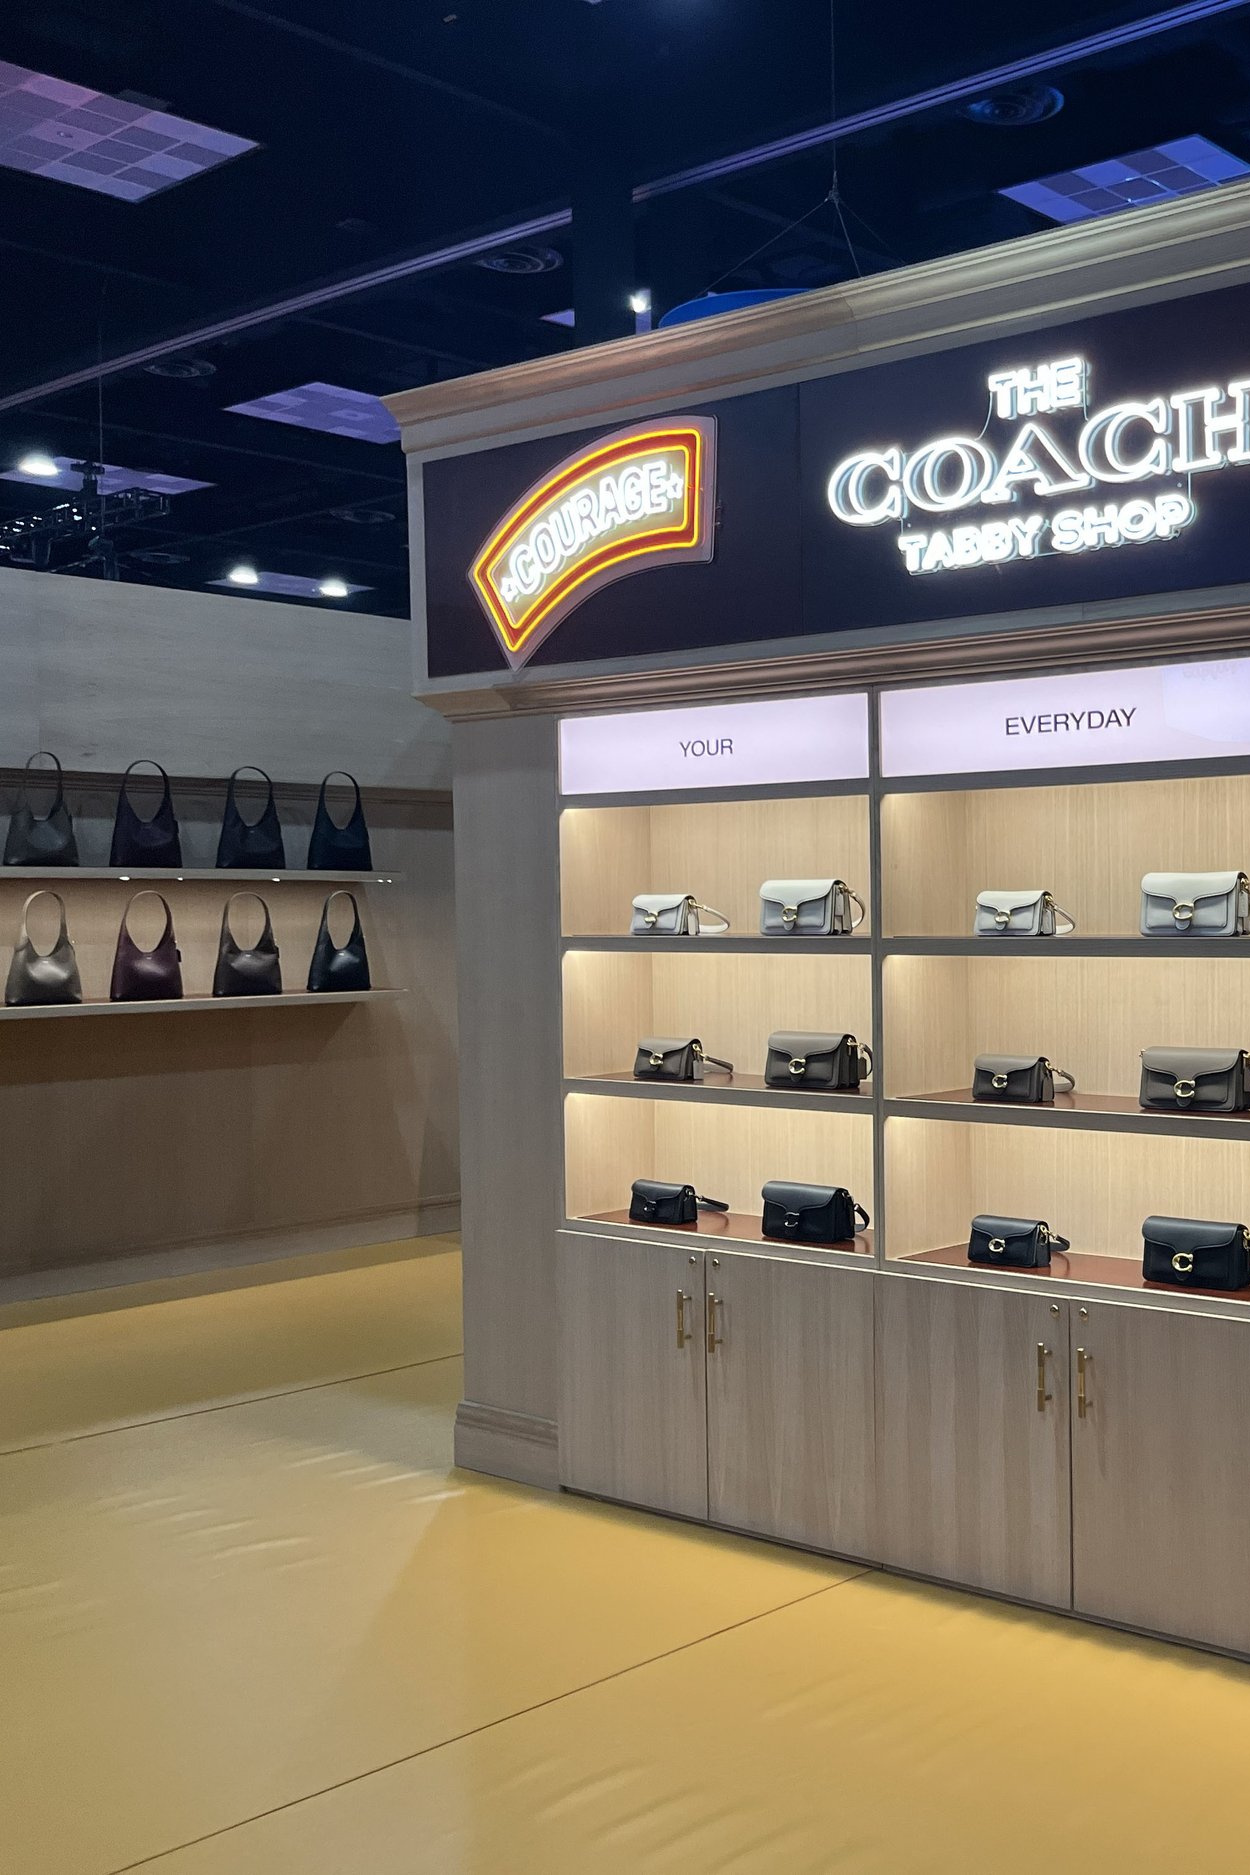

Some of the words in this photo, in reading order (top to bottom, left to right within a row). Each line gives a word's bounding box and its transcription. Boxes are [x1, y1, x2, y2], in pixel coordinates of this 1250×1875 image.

[988, 355, 1089, 419] THE
[507, 459, 671, 596] COURAGE
[898, 514, 1045, 575] TABBY
[1050, 492, 1195, 554] SHOP
[679, 738, 733, 757] YOUR
[1005, 707, 1137, 736] EVERYDAY
